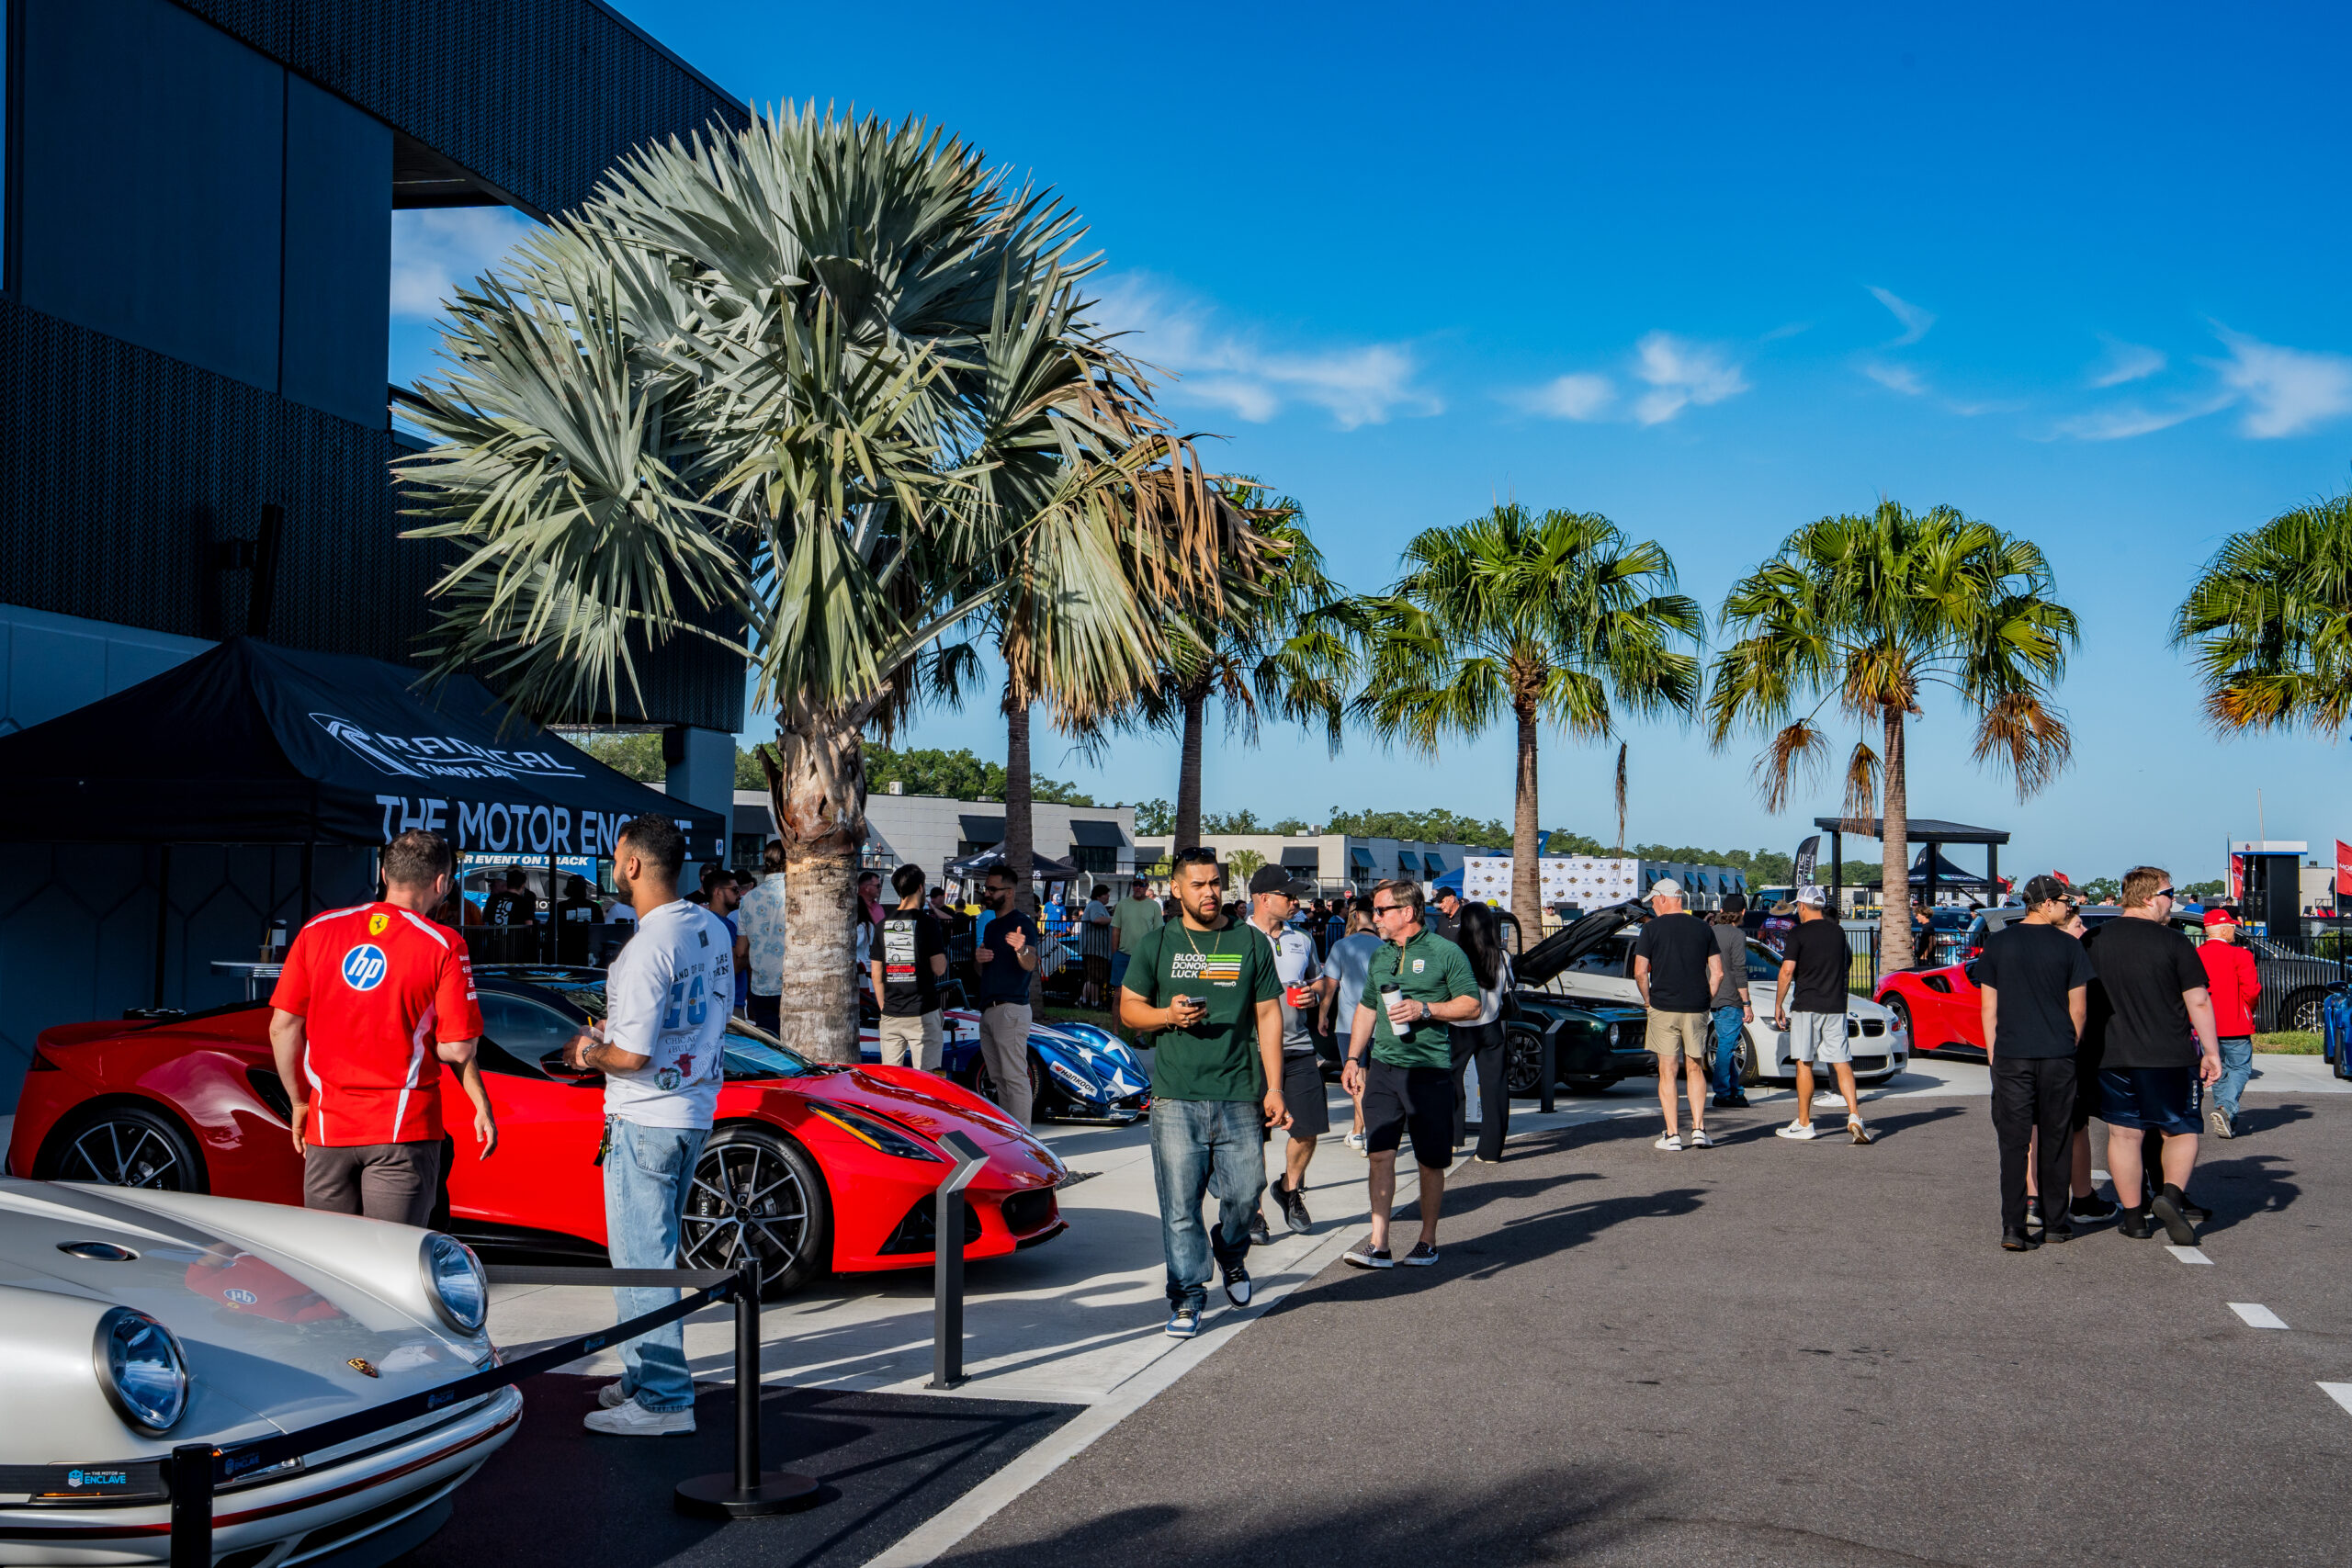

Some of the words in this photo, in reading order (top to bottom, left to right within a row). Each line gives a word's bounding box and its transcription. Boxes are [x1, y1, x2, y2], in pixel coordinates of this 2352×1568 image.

[375, 732, 576, 770] RADICAL
[415, 762, 482, 779] TAMPA
[375, 794, 450, 845] THE
[458, 800, 572, 854] MOTOR
[580, 810, 694, 861] ENCE
[475, 855, 521, 864] EVENT
[521, 855, 542, 865] ON
[544, 855, 589, 866] TRACK
[1174, 953, 1207, 963] BLOOD
[347, 945, 383, 989] hp
[1171, 962, 1208, 971] DONOR
[1170, 970, 1199, 978] LUCK
[662, 974, 707, 1029] 10
[84, 1475, 126, 1484] ENCLAVE
